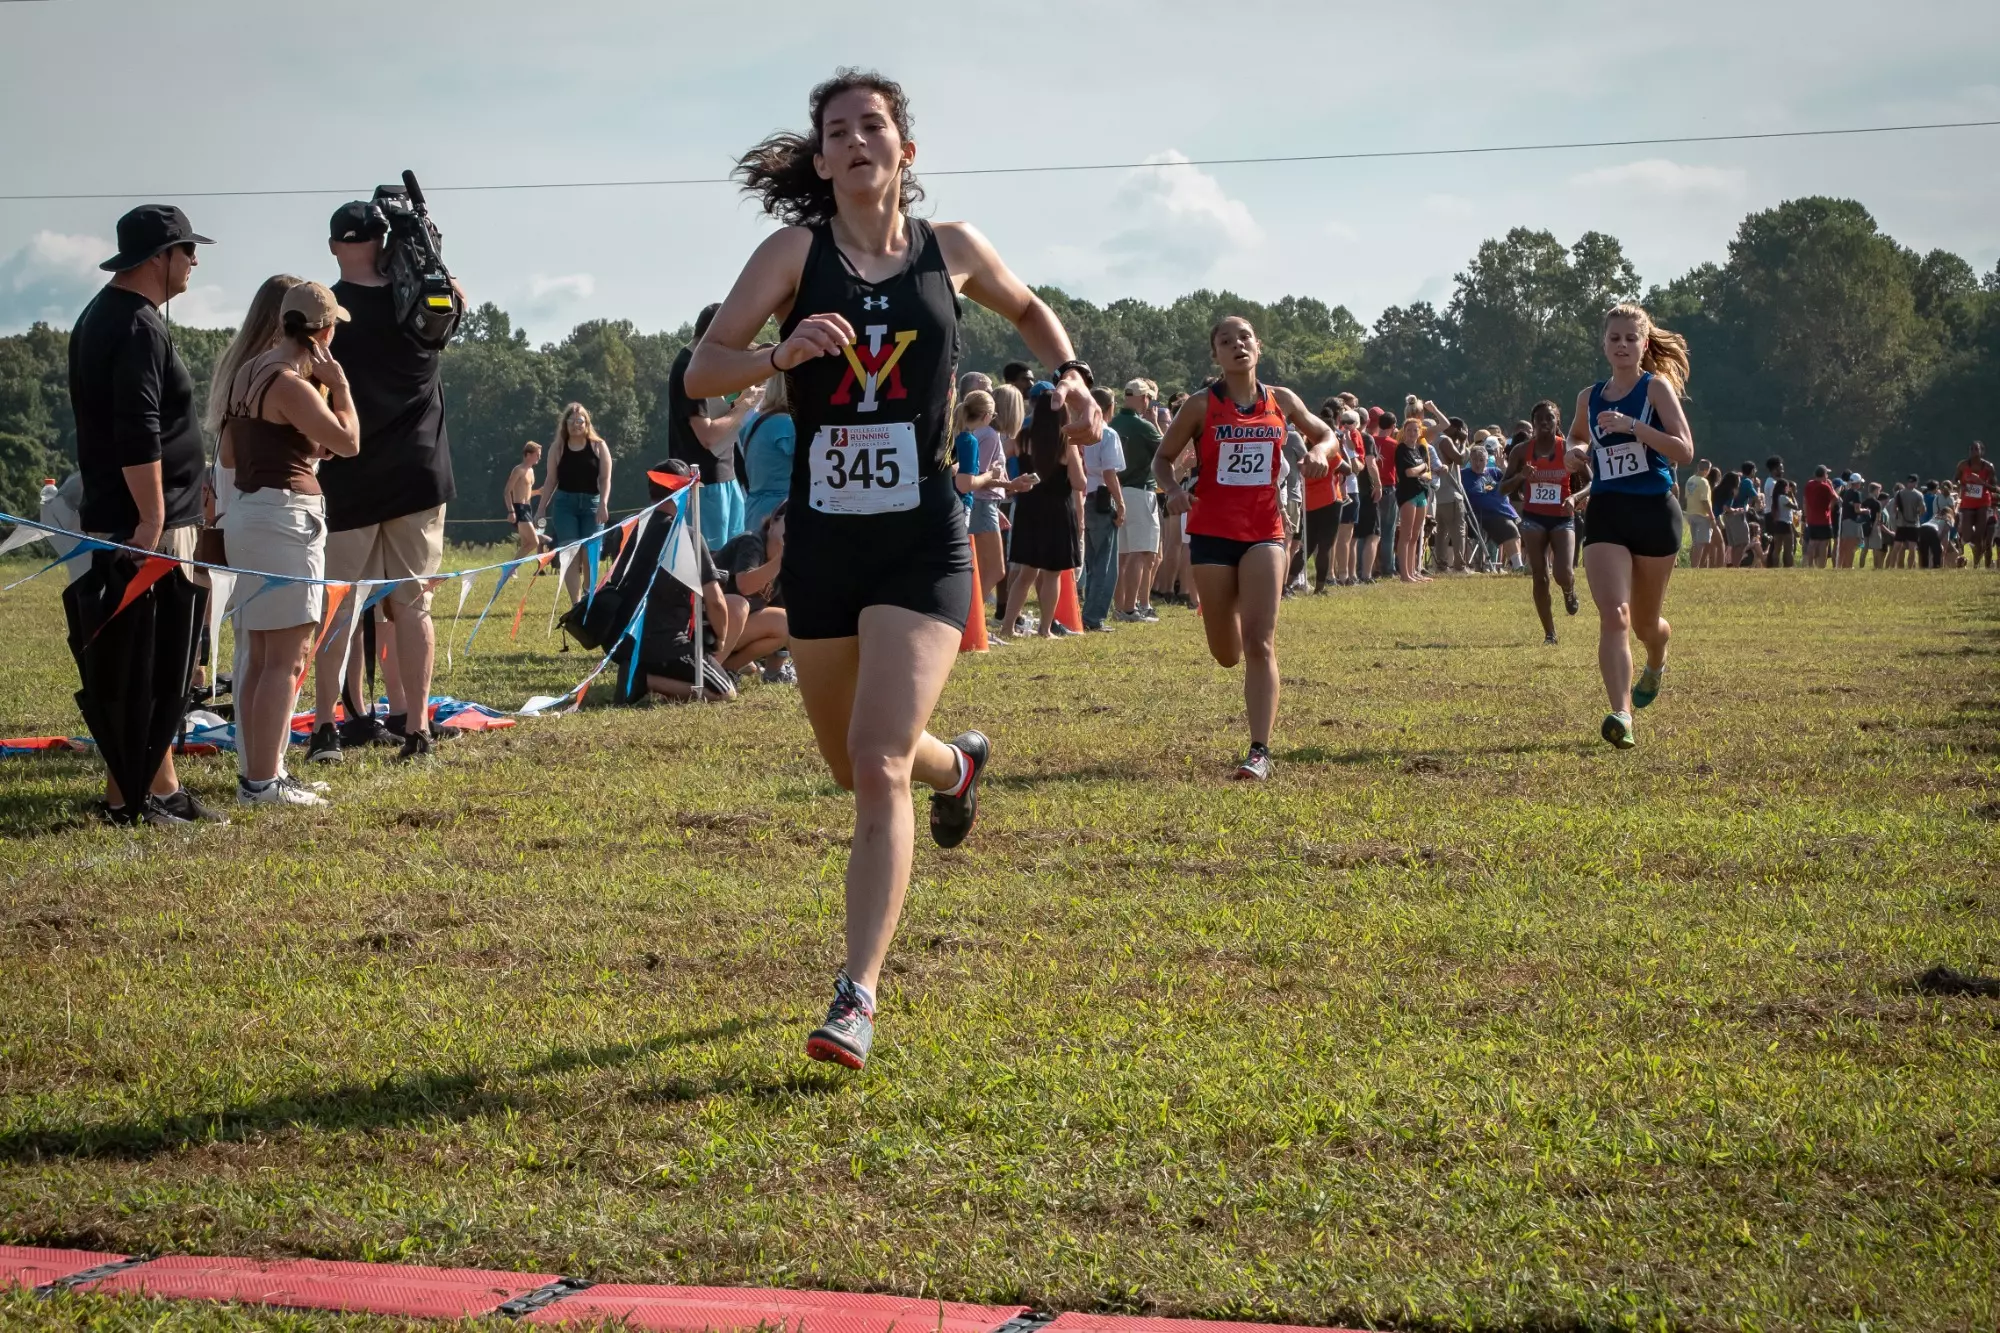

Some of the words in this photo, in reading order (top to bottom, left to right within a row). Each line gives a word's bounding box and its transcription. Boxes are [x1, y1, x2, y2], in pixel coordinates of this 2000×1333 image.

[850, 426, 890, 434] COLLEGIATE
[850, 432, 890, 441] RUNNING
[1215, 424, 1282, 440] MORGAN
[825, 447, 900, 489] 345
[1227, 453, 1265, 474] 252
[1606, 453, 1639, 476] 173
[1535, 488, 1556, 501] 328
